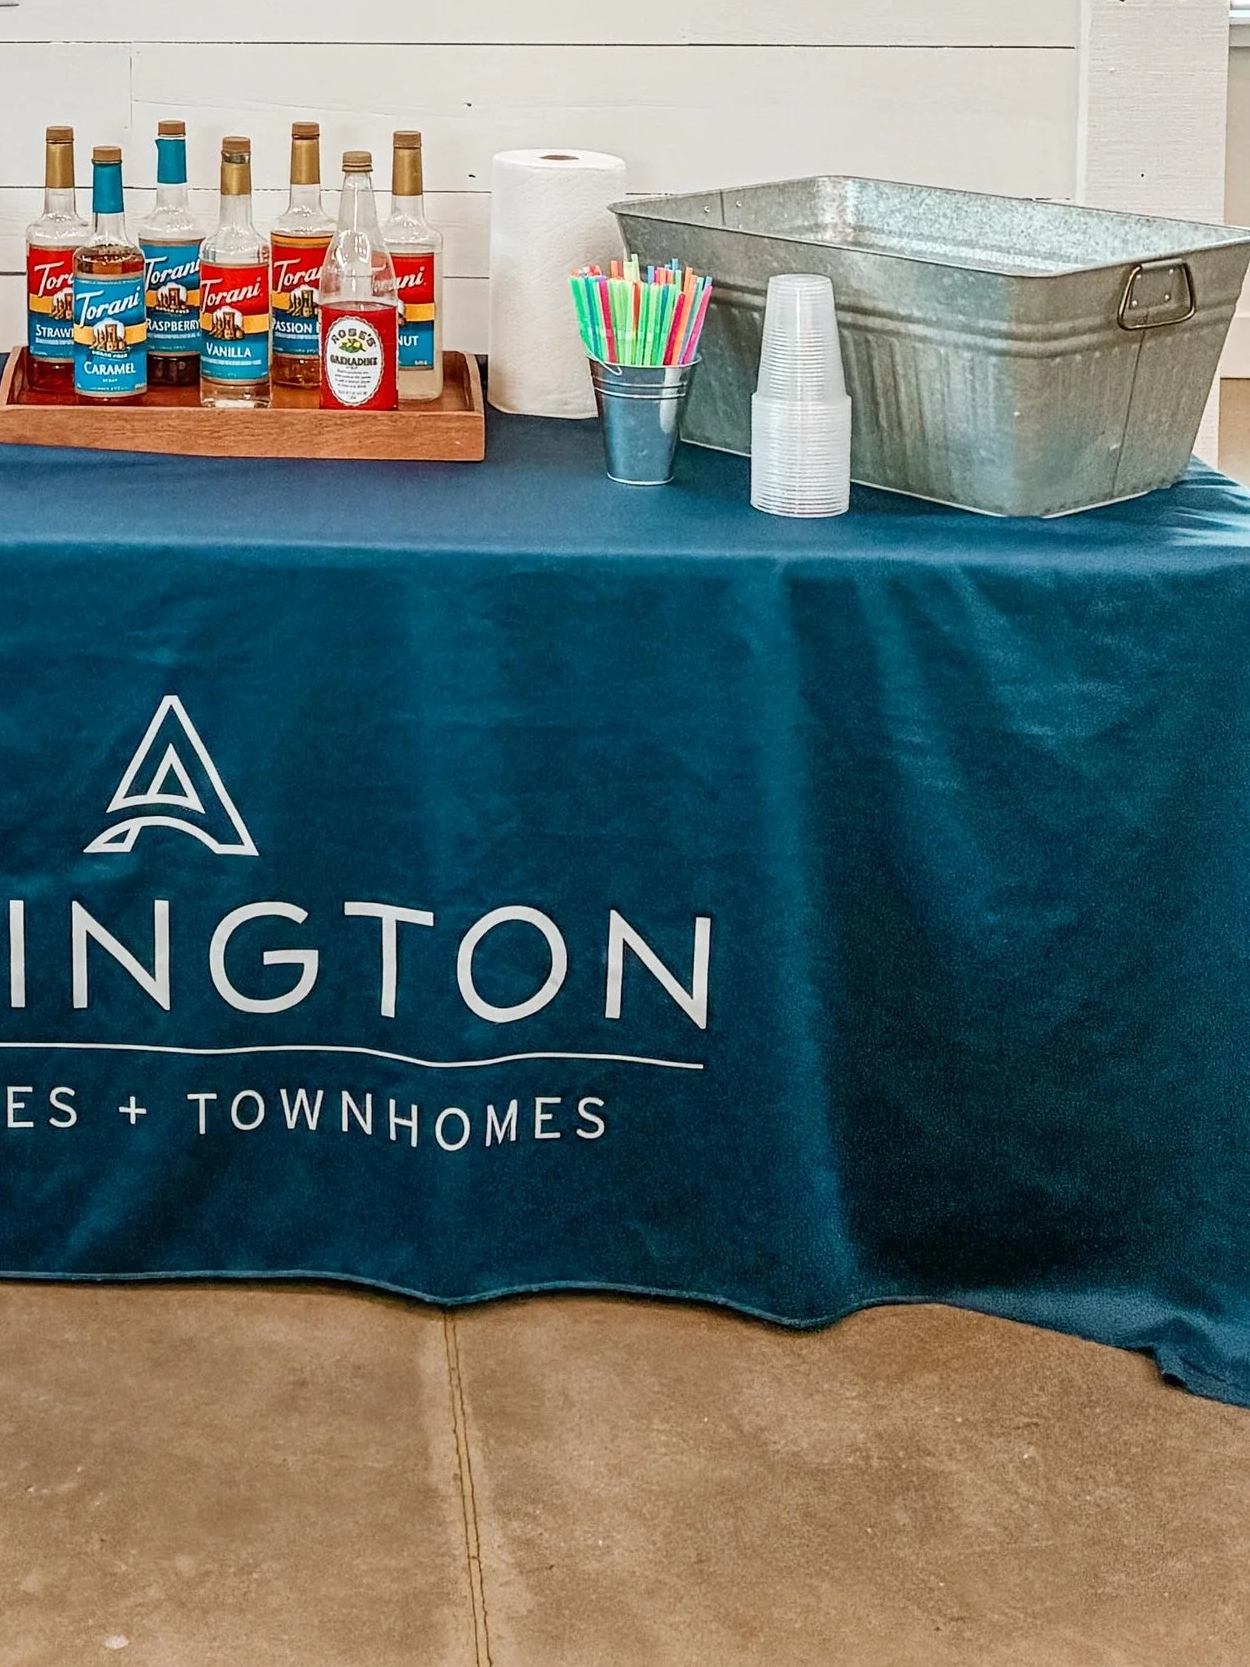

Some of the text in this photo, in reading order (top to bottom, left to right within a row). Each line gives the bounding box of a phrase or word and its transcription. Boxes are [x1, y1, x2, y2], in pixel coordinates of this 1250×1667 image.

[76, 286, 141, 328] Torani
[200, 277, 261, 314] Torani
[35, 324, 74, 338] STRAW
[206, 342, 252, 357] VANILLA
[84, 361, 136, 375] CARAMEL
[118, 1096, 147, 1125] +
[187, 1088, 605, 1151] TOWNHOMES
